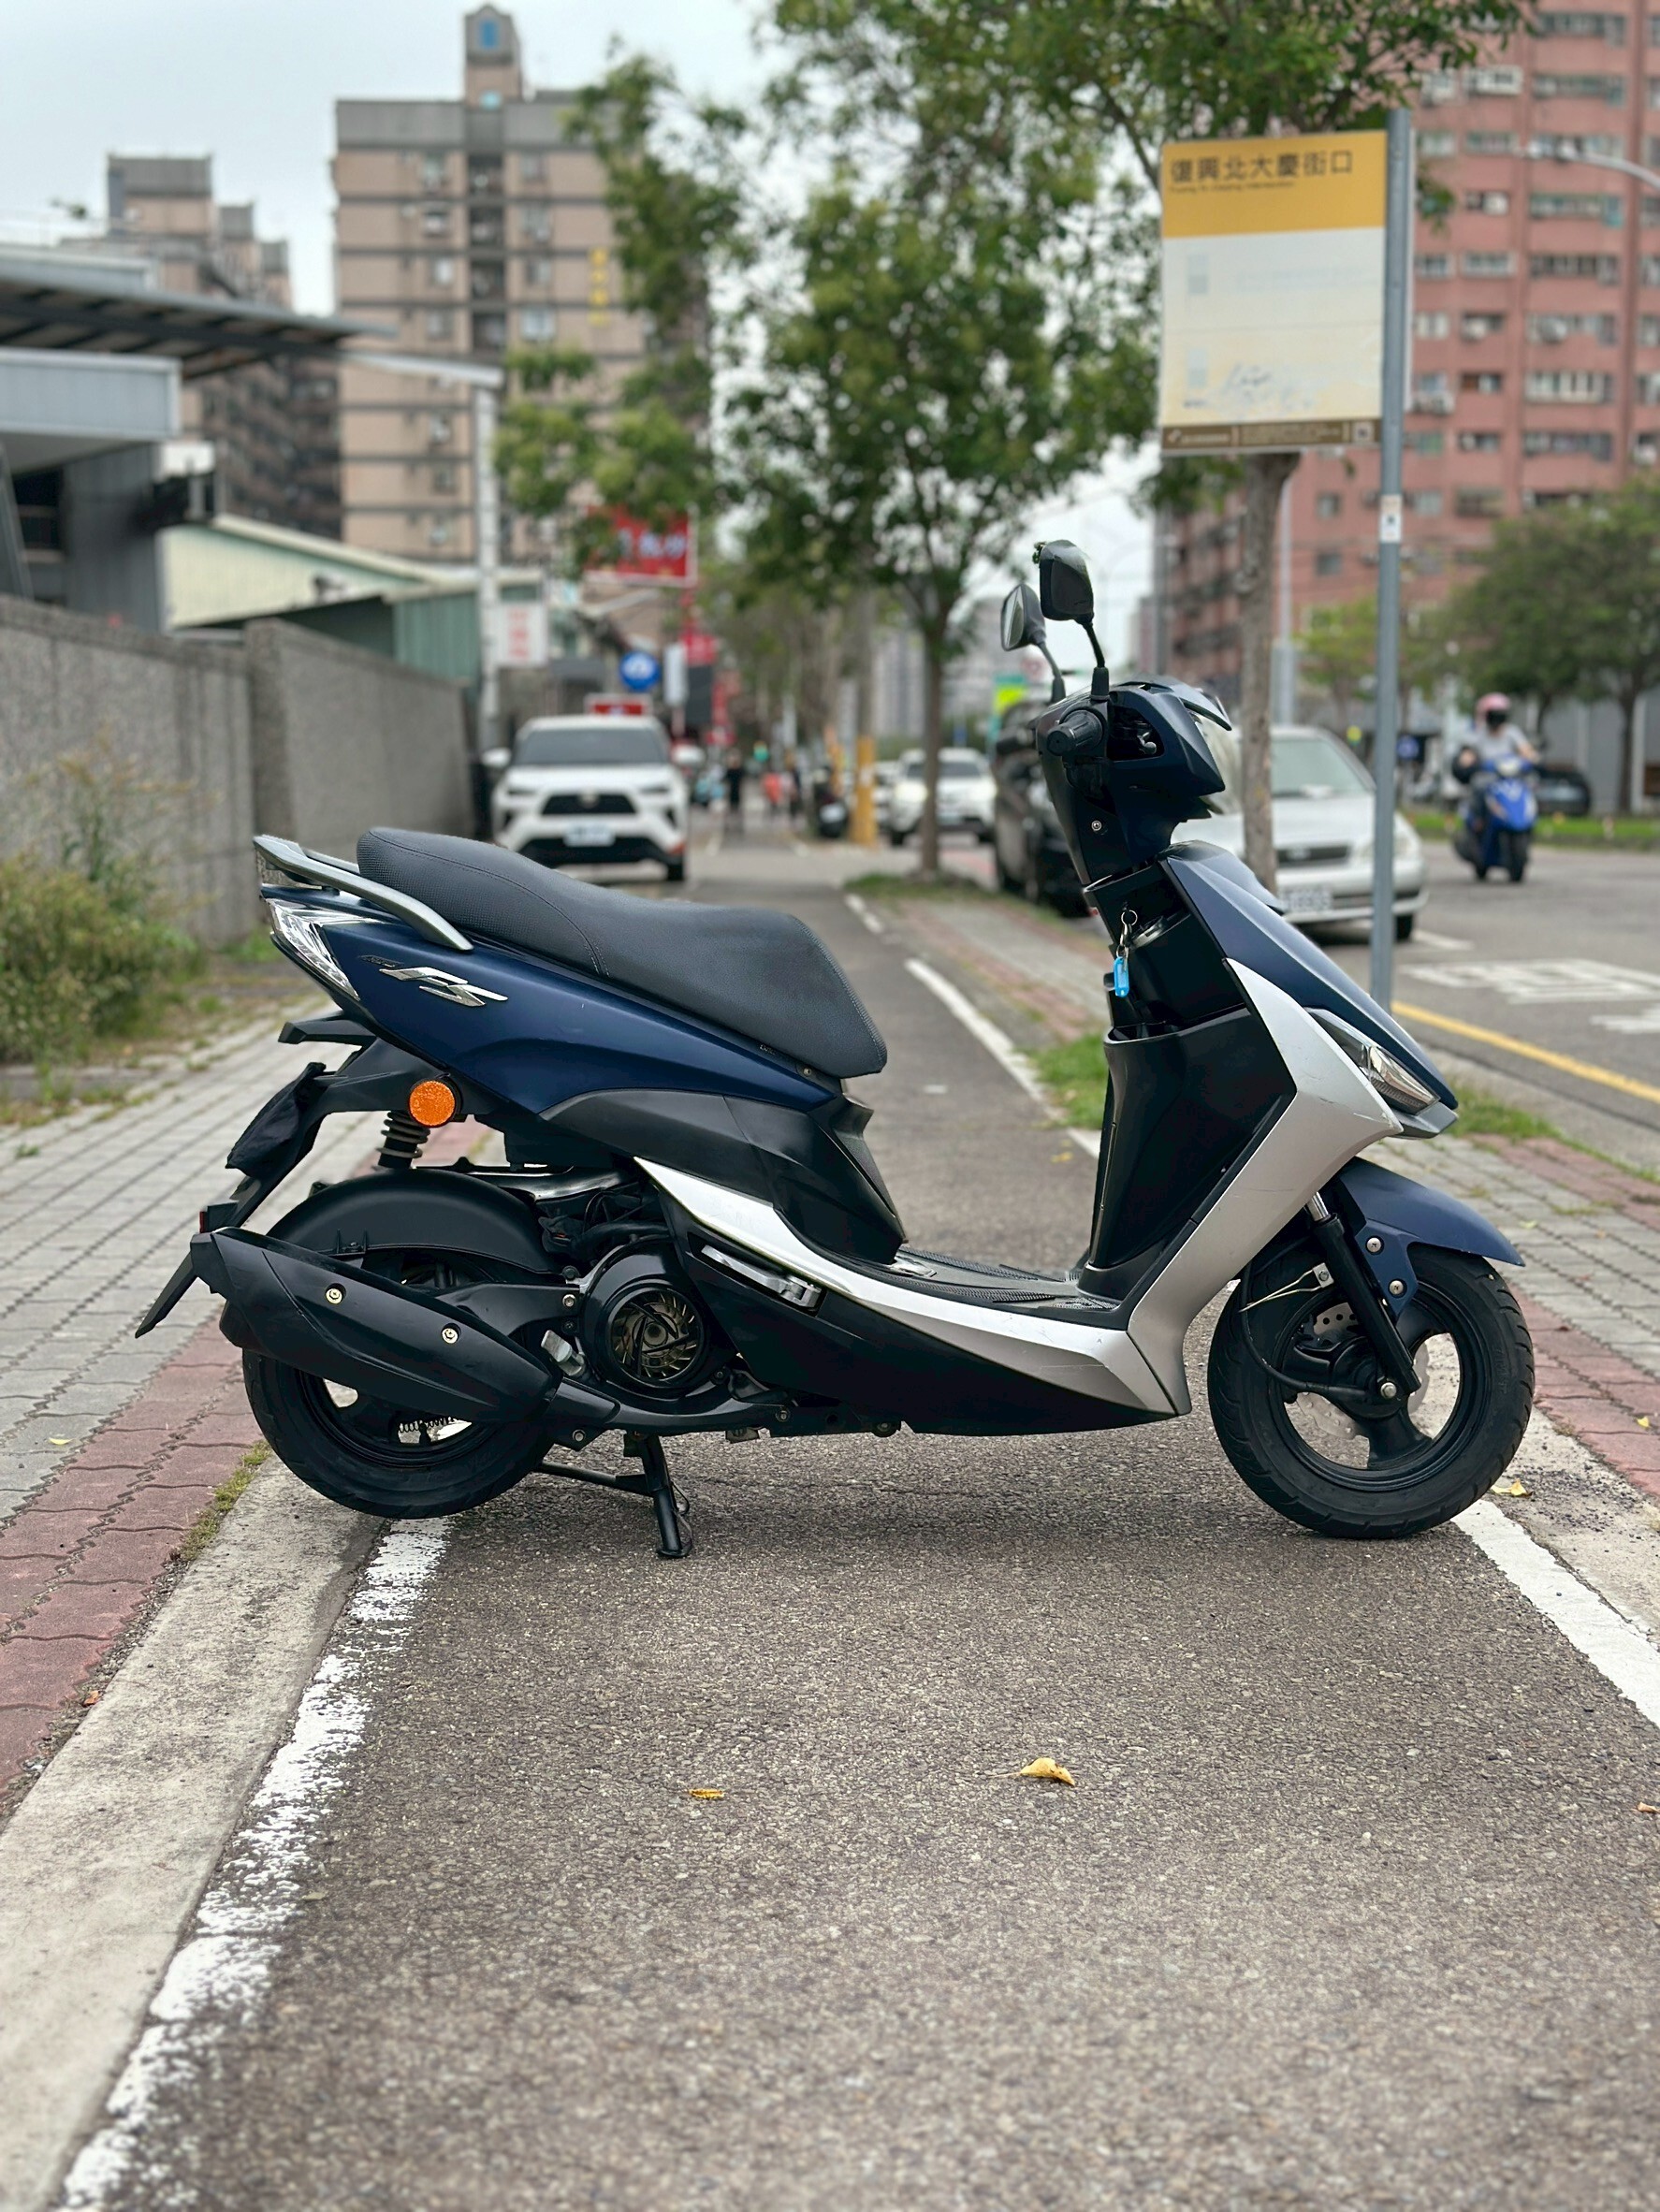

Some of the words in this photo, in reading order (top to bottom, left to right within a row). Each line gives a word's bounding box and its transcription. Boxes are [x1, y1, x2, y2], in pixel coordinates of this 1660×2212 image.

[1172, 150, 1353, 183] 復興北大慶街口
